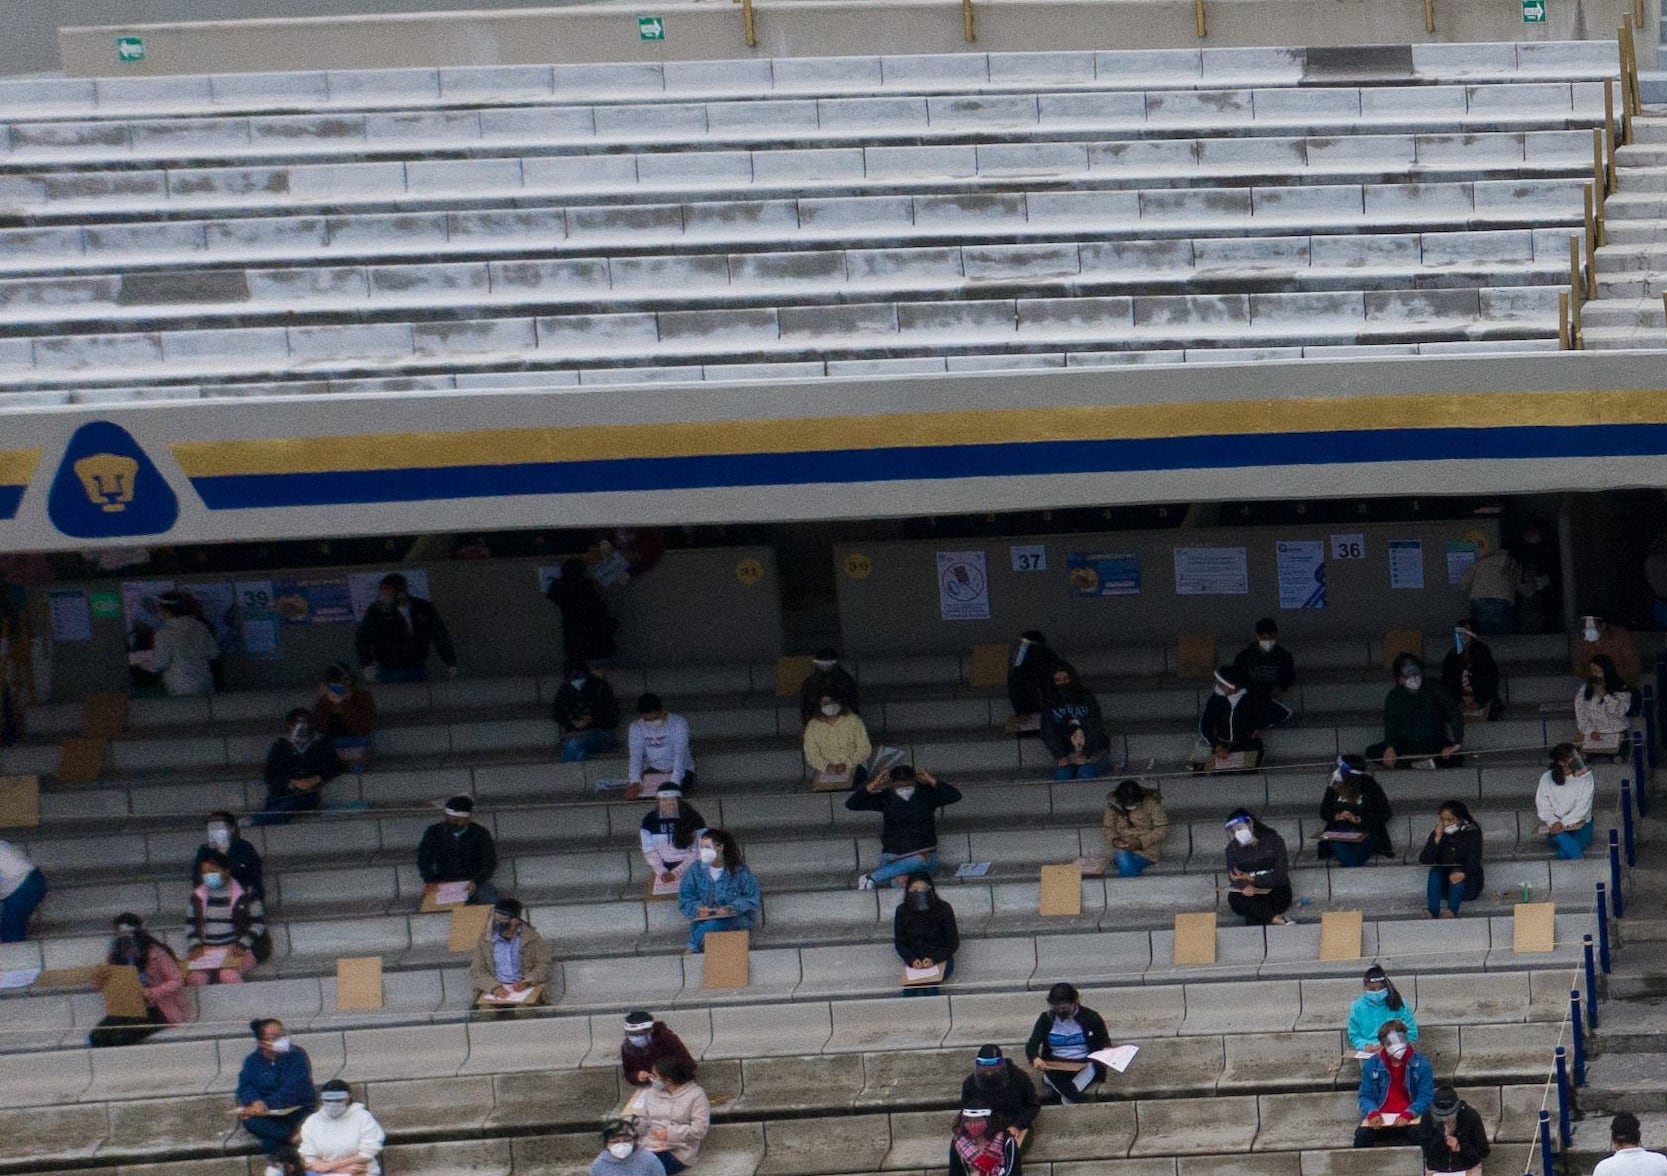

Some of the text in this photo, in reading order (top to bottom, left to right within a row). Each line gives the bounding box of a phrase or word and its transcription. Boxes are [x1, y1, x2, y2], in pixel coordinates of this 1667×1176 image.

[1338, 543, 1361, 558] 36
[1019, 554, 1041, 570] 37
[244, 591, 268, 607] 39
